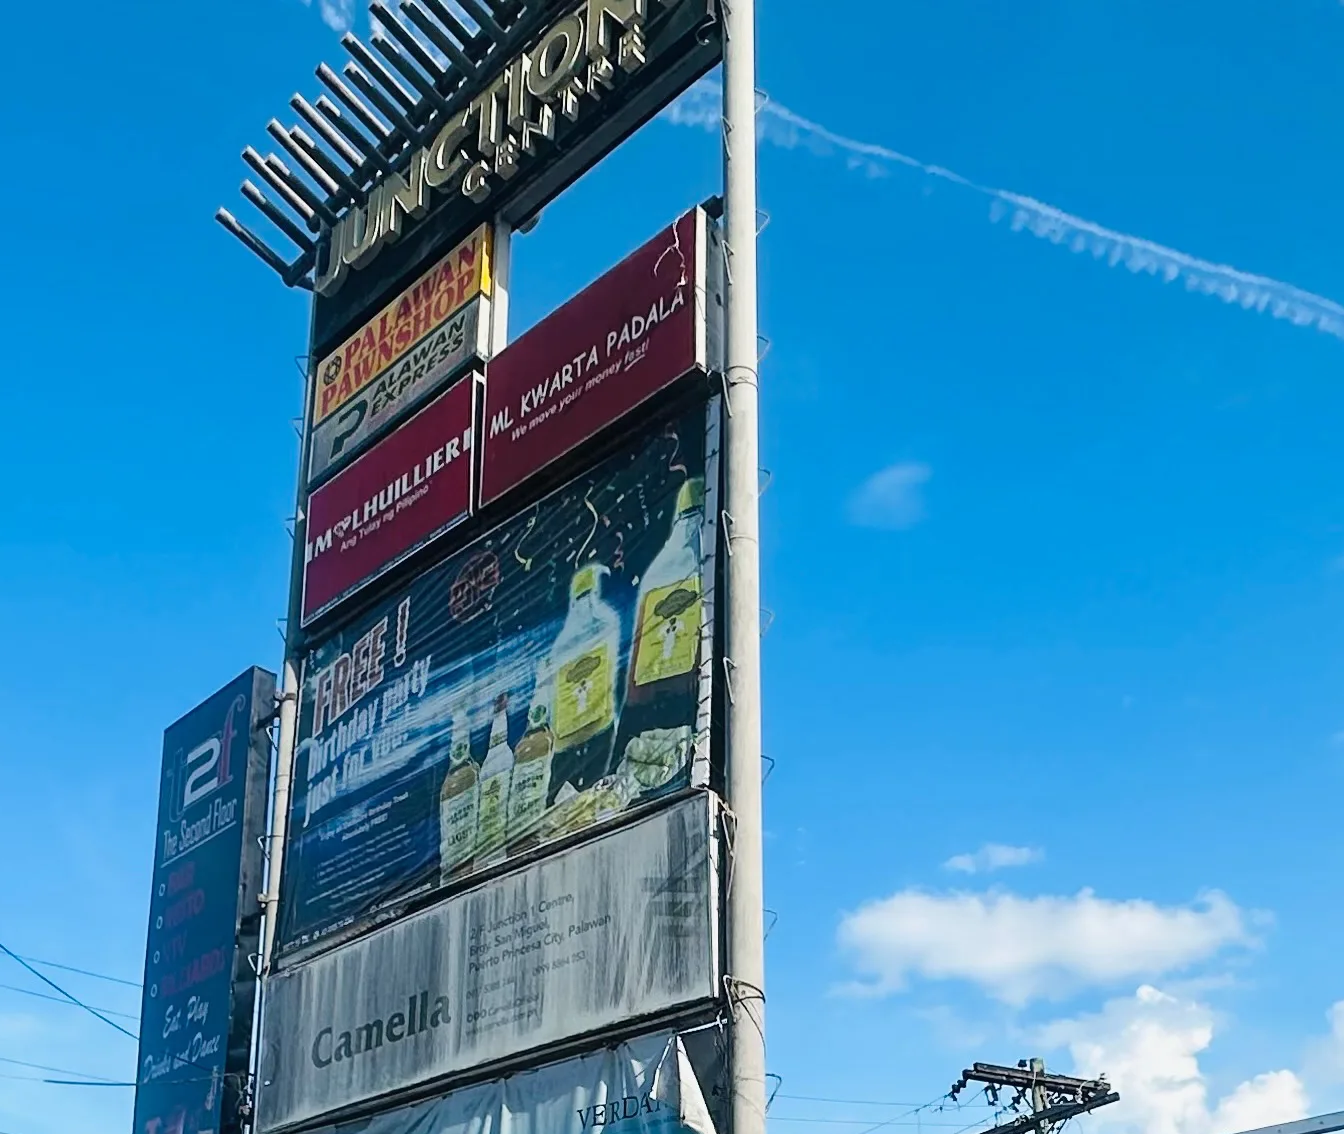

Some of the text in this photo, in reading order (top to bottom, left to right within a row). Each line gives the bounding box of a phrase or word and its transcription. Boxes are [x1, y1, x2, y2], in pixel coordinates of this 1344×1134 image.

[314, 0, 646, 298] JUNCTION
[320, 268, 476, 418] PAWNSHOP
[344, 237, 478, 368] PALAWAN
[370, 332, 465, 419] EXPRESS
[490, 287, 685, 440] ML KWARTA PADALA
[511, 424, 527, 442] We
[529, 403, 557, 430] move
[558, 385, 583, 412] your
[585, 359, 621, 391] money
[163, 798, 237, 861] The Second Floor
[468, 954, 500, 974] Puerto
[568, 914, 612, 938] Palawan
[494, 931, 513, 948] San
[311, 990, 452, 1069] Camella
